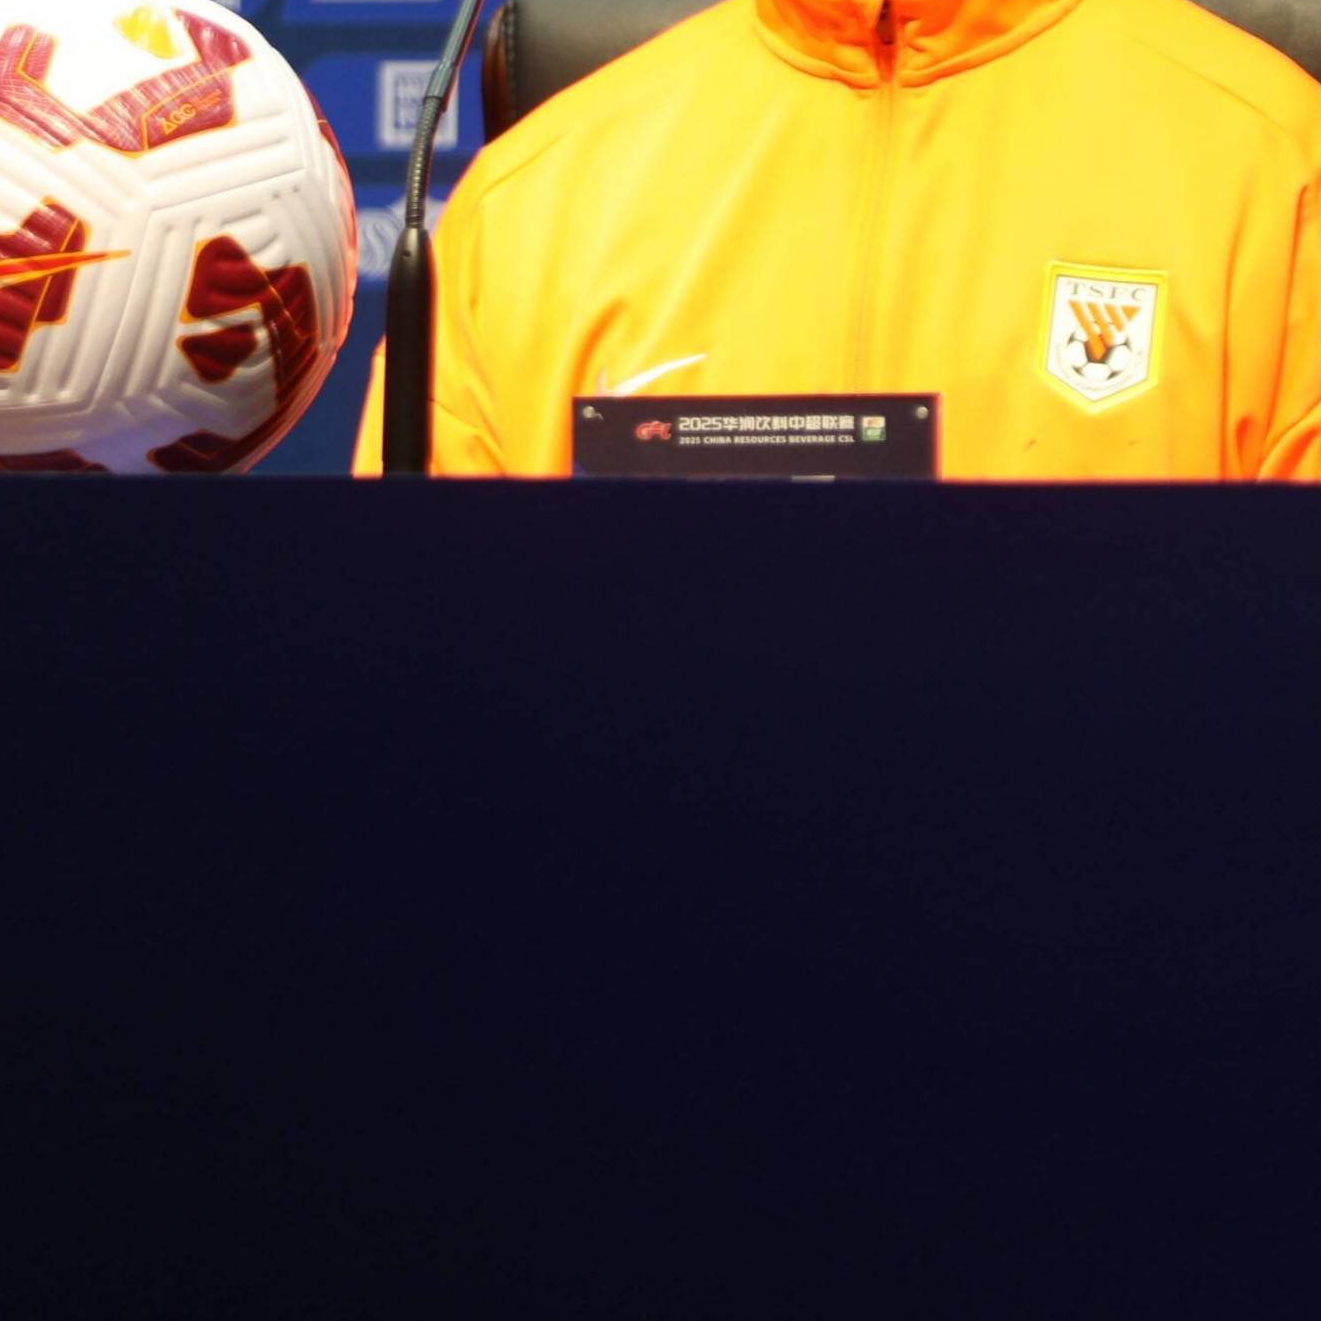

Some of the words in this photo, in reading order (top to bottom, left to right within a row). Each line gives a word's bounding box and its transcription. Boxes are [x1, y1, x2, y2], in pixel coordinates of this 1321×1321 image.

[679, 415, 855, 432] 2025华润饮料中超联赛
